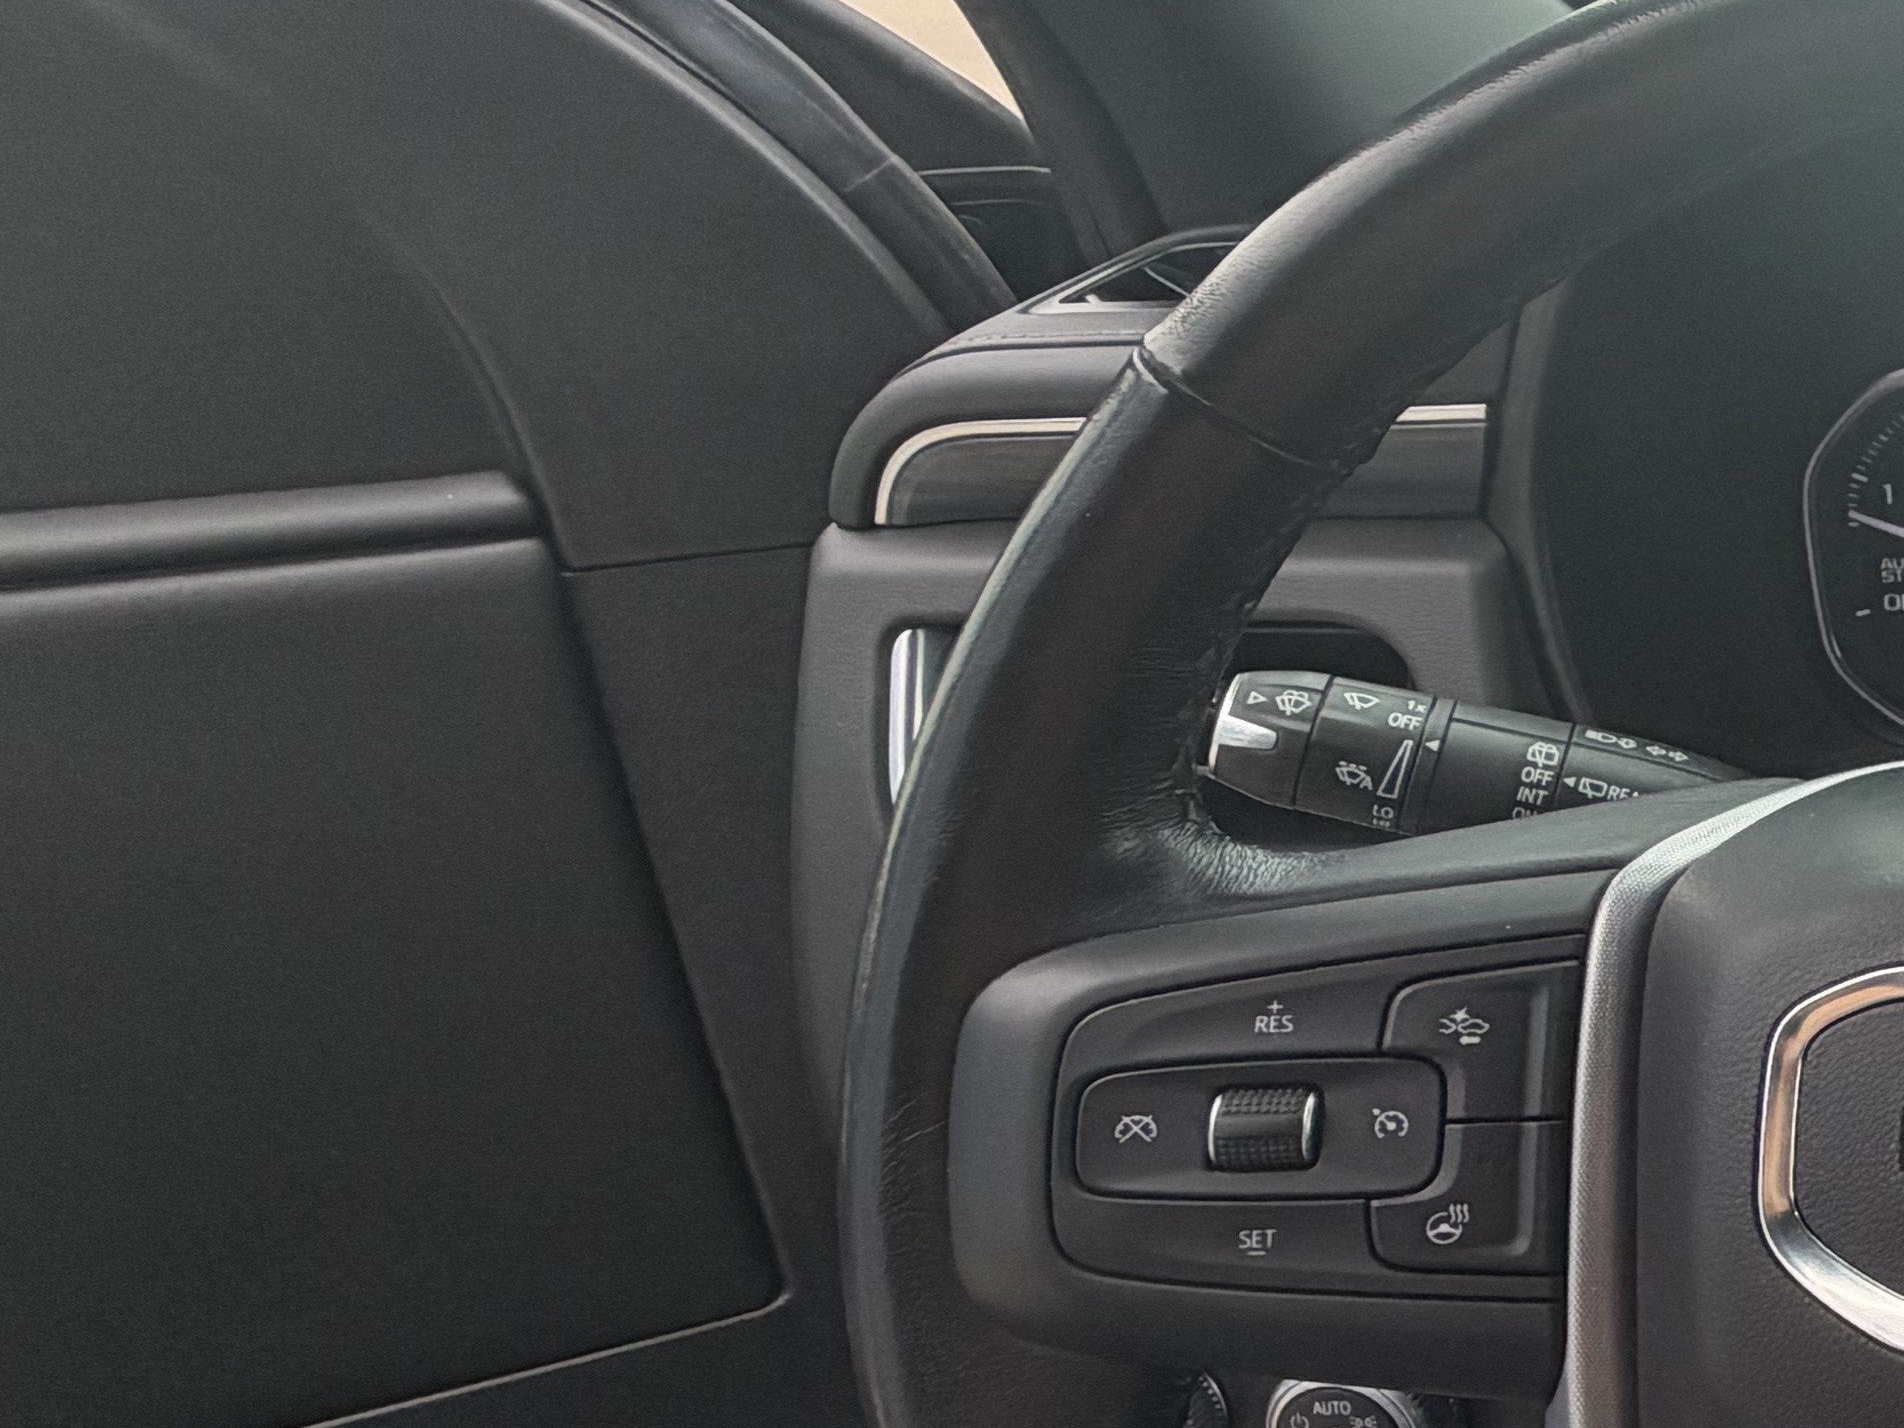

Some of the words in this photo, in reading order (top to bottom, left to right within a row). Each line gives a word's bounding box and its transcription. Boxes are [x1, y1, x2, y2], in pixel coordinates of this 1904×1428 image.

[1883, 483, 1894, 504] 1
[1387, 712, 1423, 731] OFF
[1520, 766, 1555, 786] OFF
[1516, 786, 1548, 806] INT
[1372, 804, 1394, 819] LO
[1254, 1014, 1294, 1033] RES
[1238, 1228, 1277, 1249] SET
[1312, 1400, 1351, 1417] AUTO
